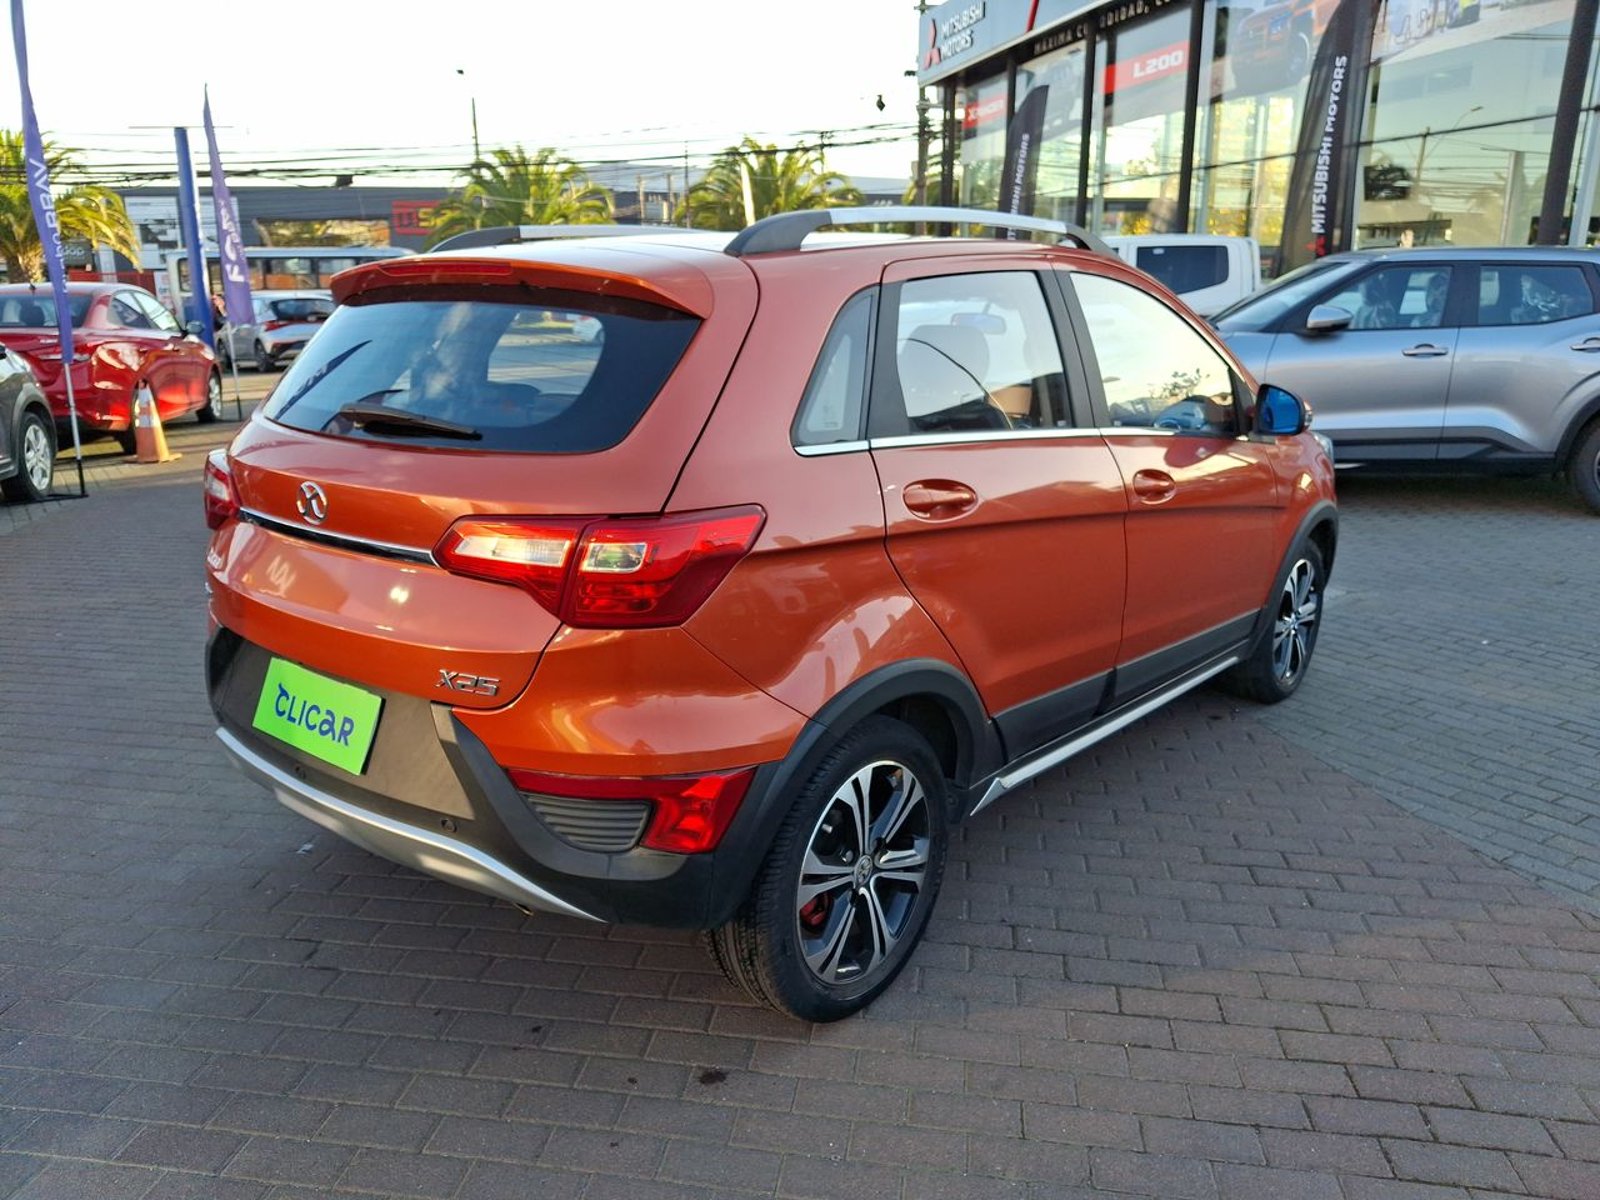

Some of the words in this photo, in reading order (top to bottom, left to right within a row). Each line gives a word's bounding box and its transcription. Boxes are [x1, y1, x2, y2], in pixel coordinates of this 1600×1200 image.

[1133, 50, 1184, 78] L200
[1014, 133, 1030, 185] MOTORS
[1311, 136, 1334, 234] MITSUBISHI
[1325, 55, 1348, 134] MOTORS
[435, 669, 501, 697] X25
